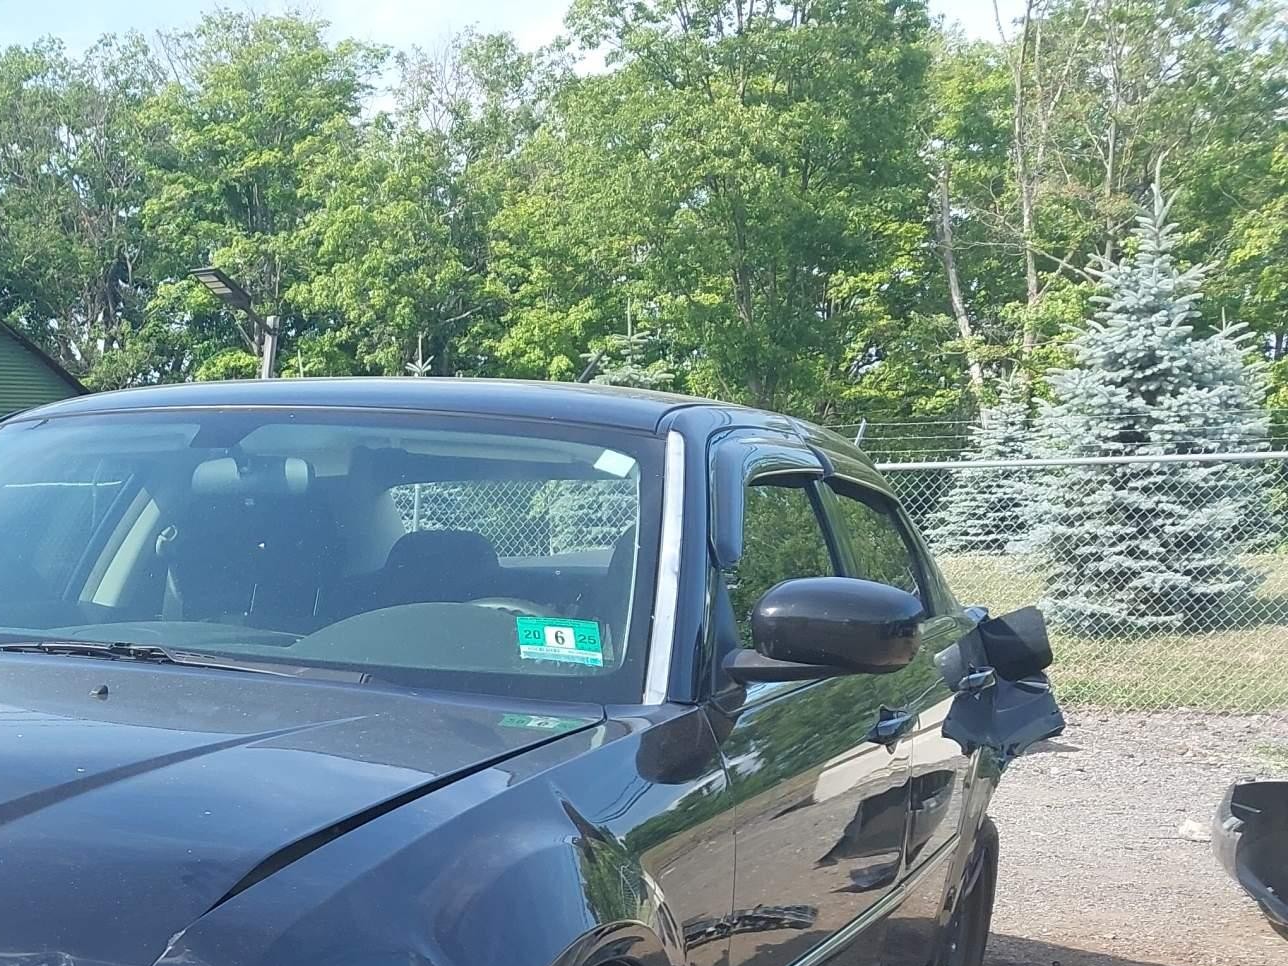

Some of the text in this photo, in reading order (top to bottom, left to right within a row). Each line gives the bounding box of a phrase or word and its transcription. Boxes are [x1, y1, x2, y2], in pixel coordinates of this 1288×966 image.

[523, 629, 597, 646] 20 6 25
